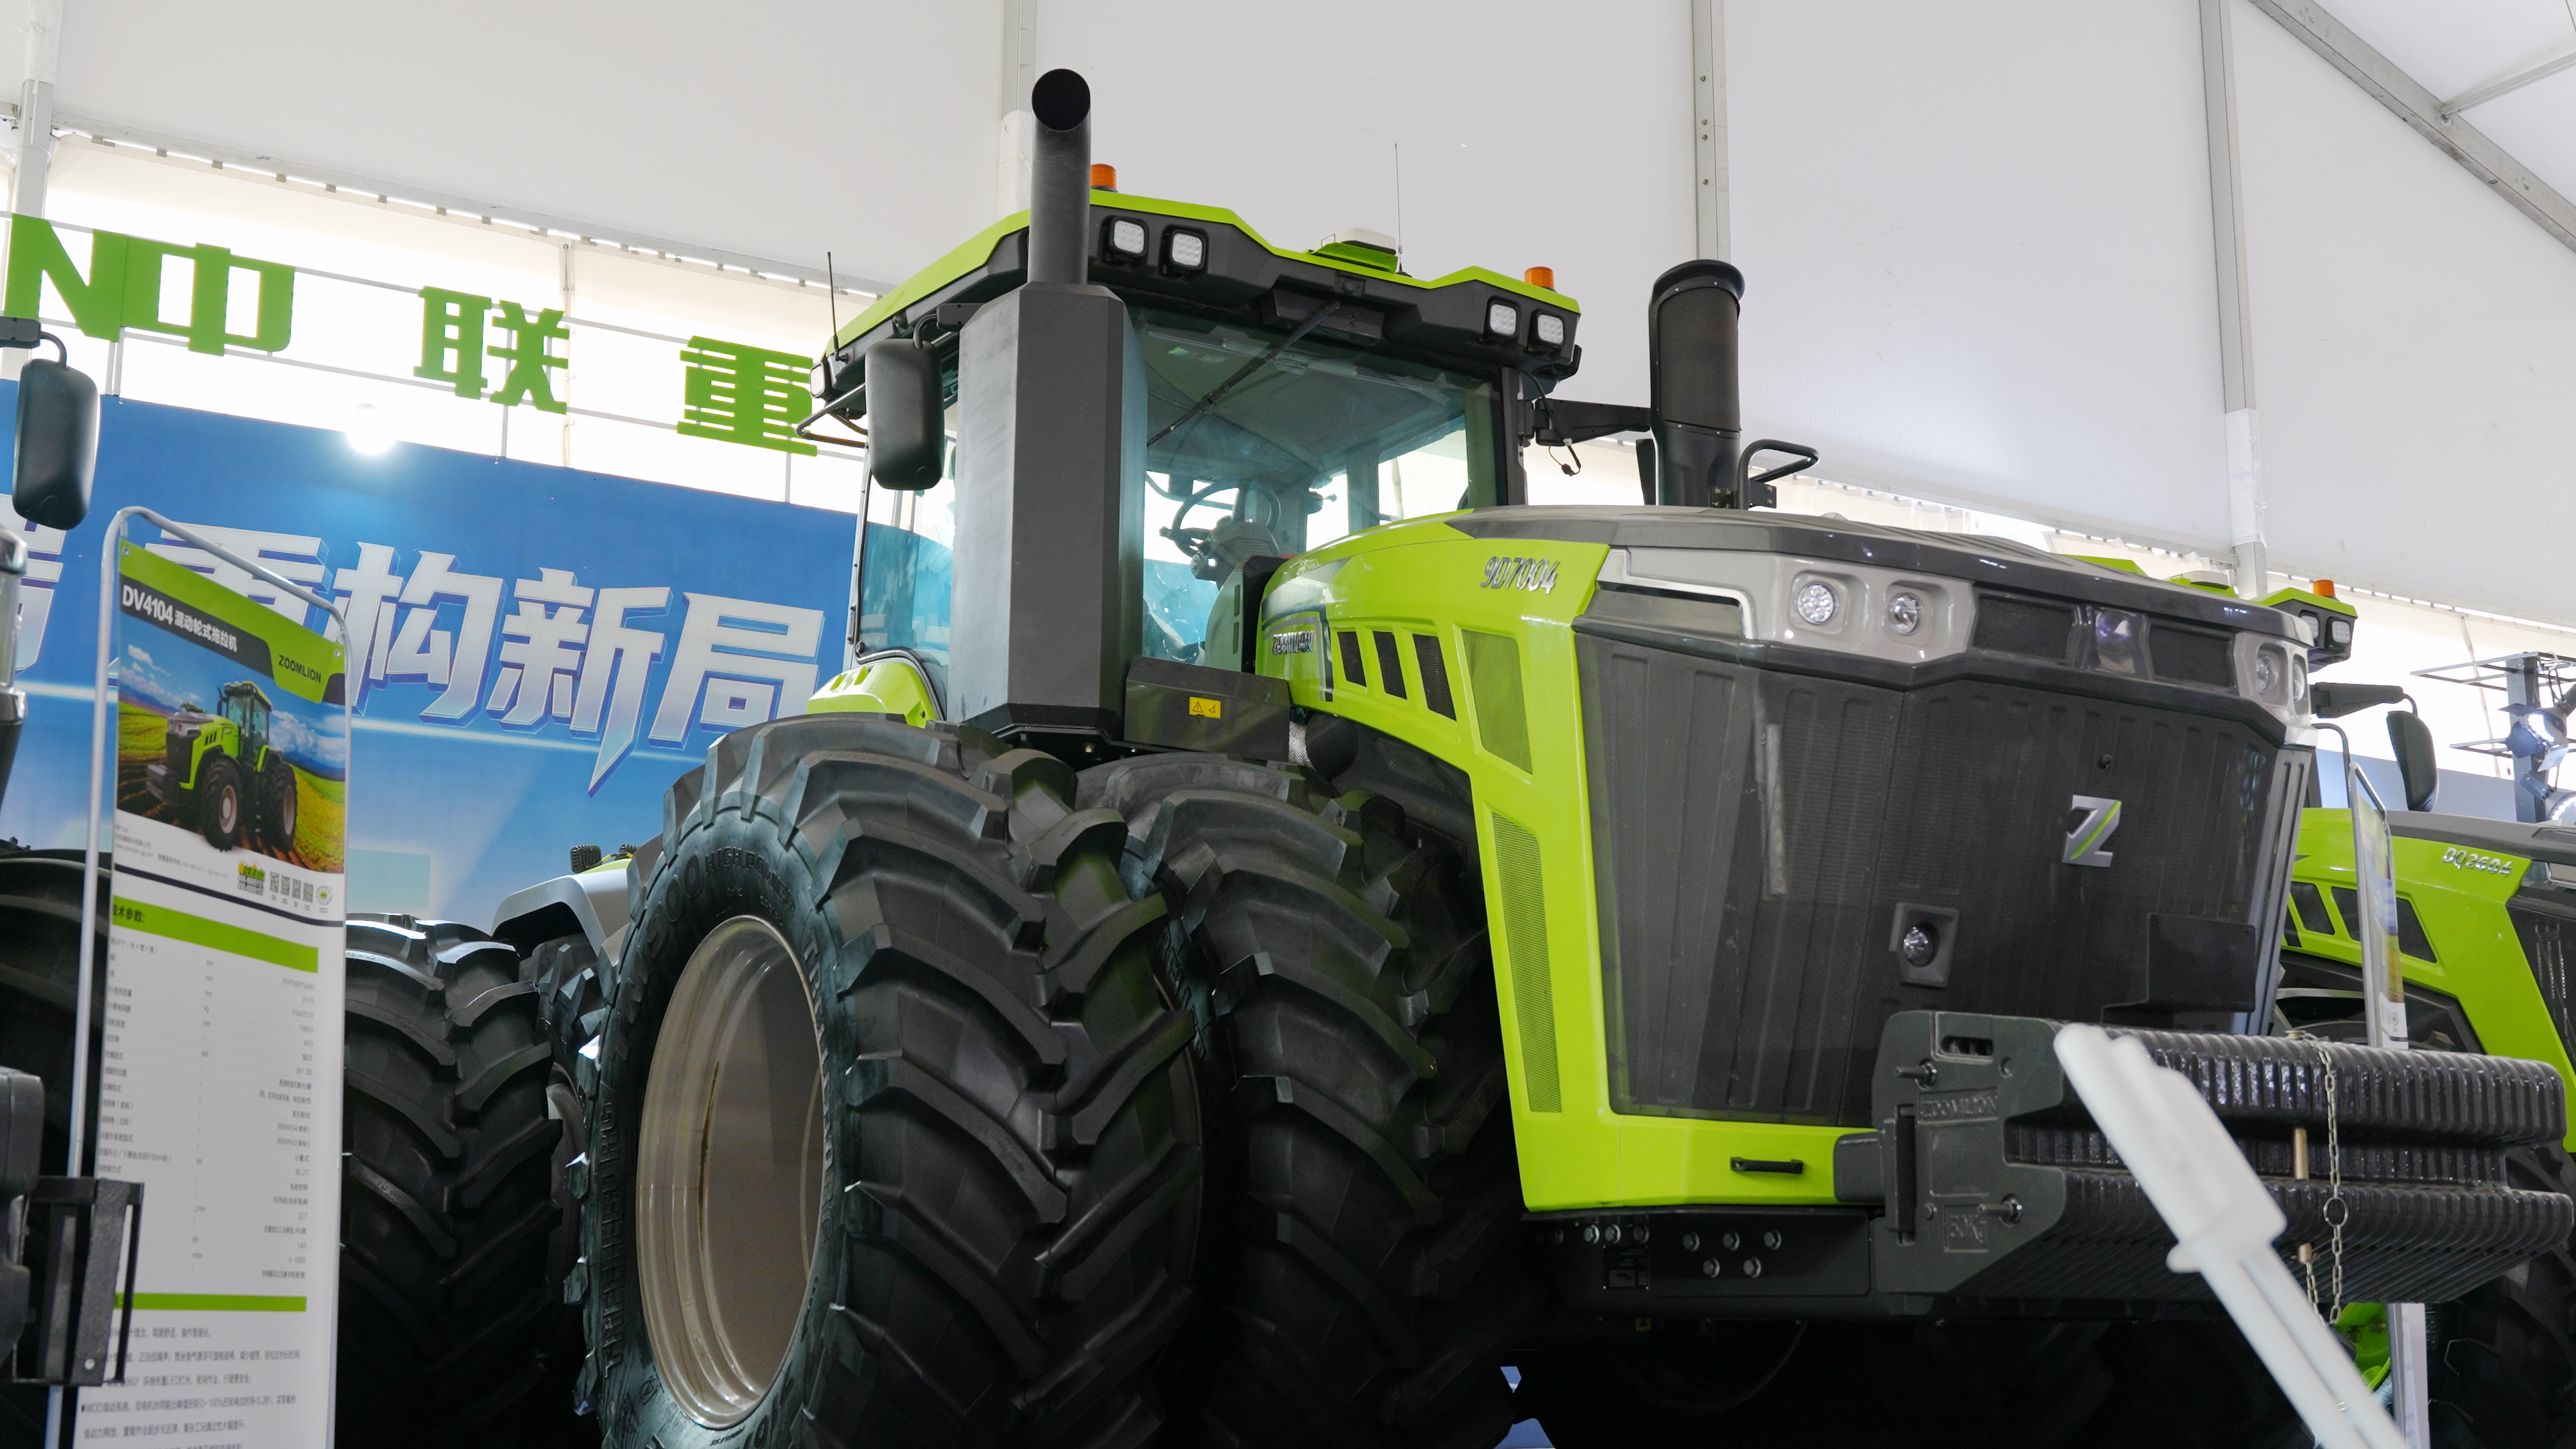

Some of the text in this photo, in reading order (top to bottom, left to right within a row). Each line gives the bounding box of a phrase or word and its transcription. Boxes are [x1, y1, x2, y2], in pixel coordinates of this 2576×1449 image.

[122, 584, 238, 653] DV4104 混动轮式拖拉机
[278, 655, 322, 684] ZOOMLION
[2443, 847, 2512, 877] DQ2604
